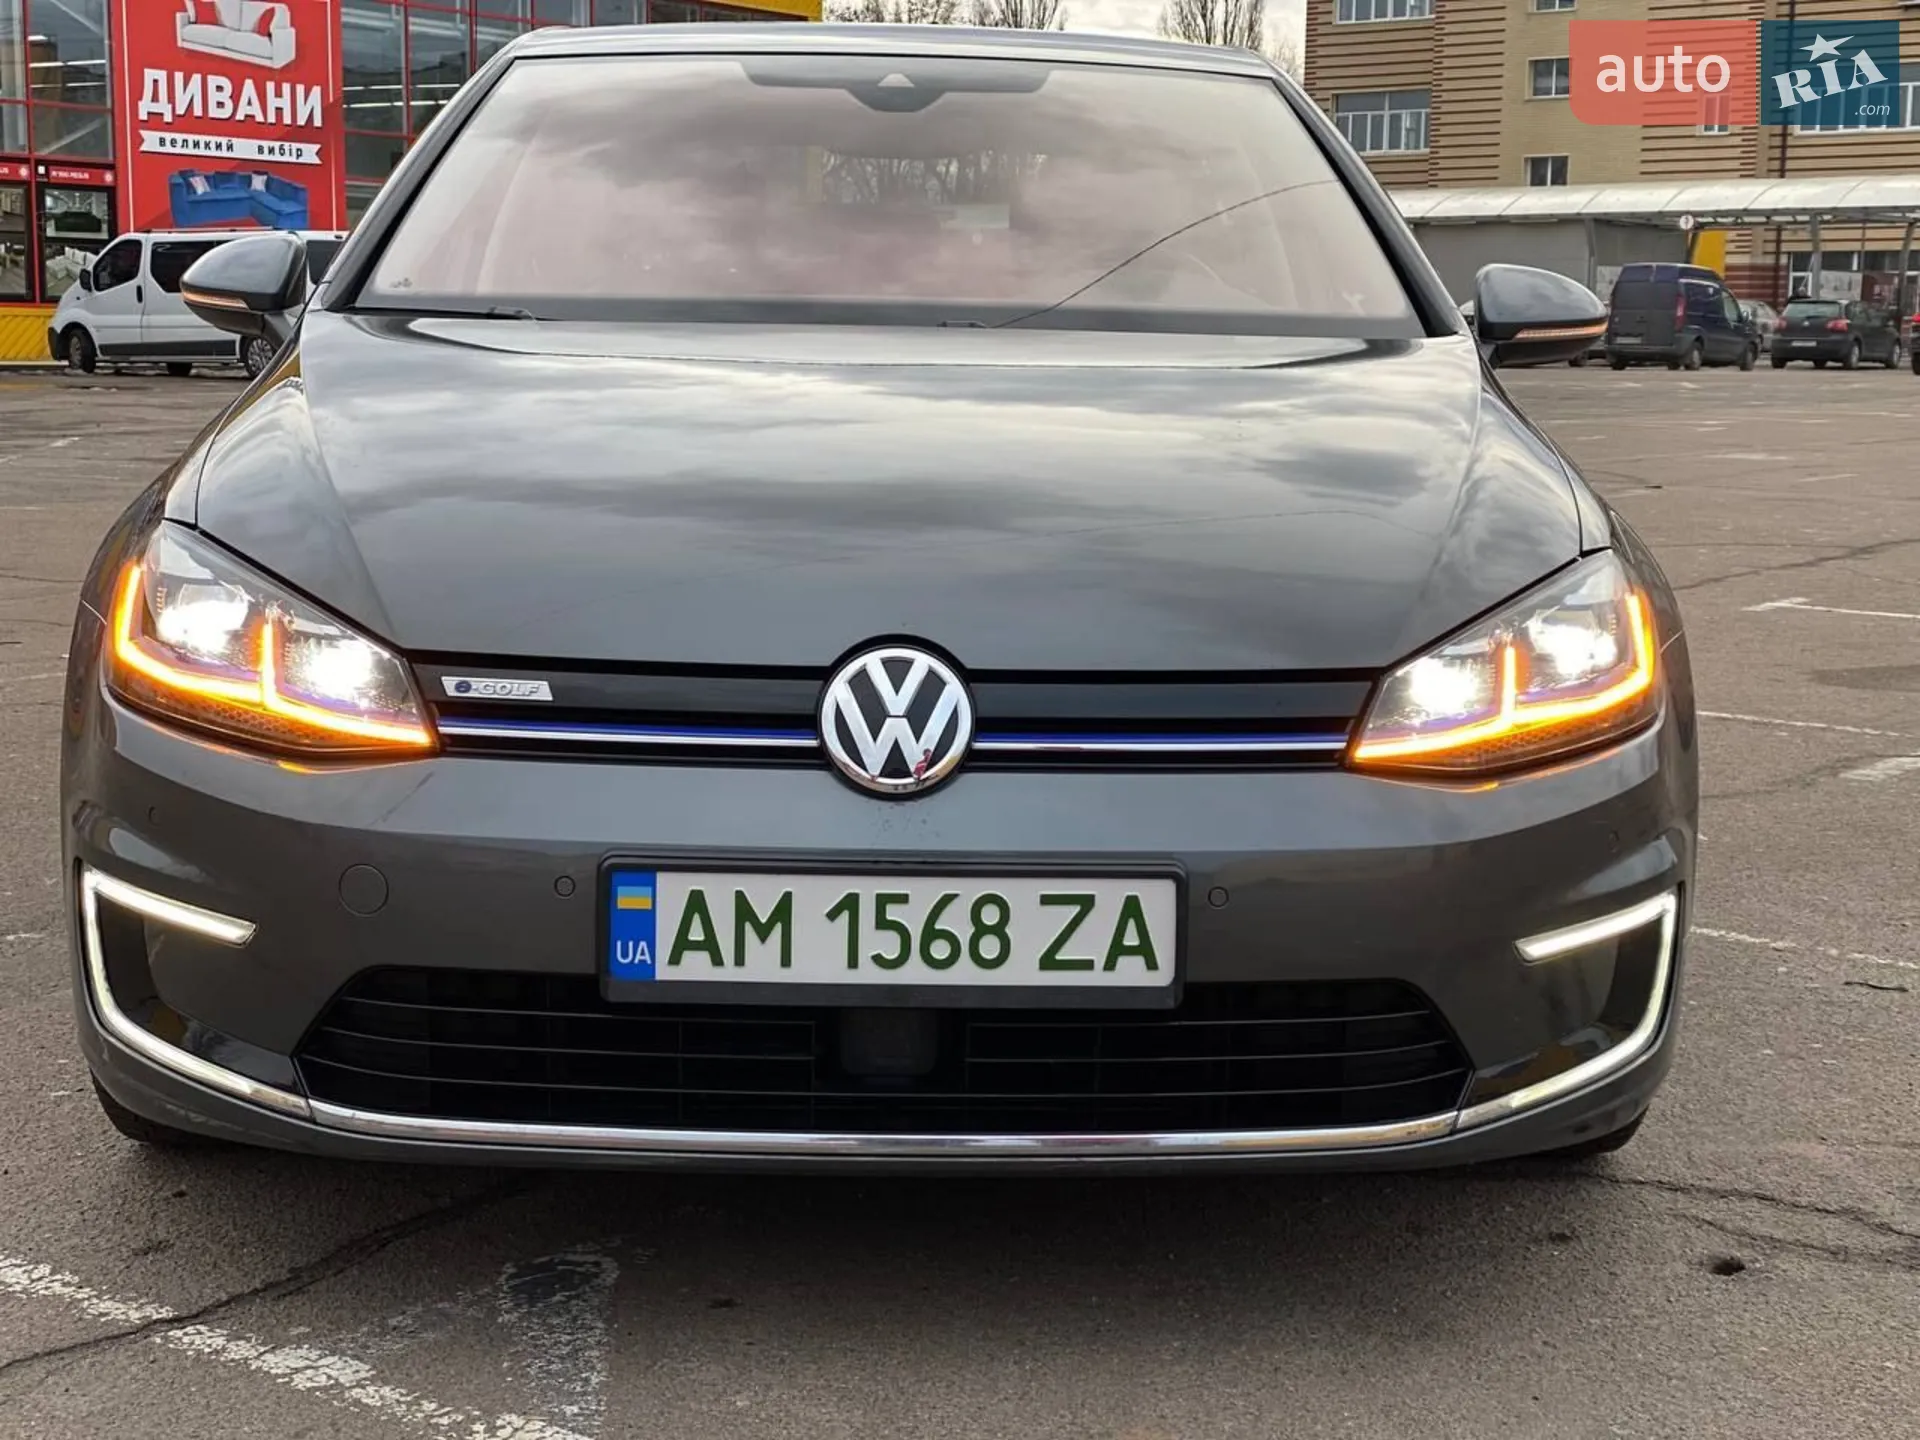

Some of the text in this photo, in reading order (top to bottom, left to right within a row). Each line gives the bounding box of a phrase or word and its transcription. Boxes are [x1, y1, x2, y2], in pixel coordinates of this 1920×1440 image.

[138, 68, 323, 128] ДИВАНИ
[158, 136, 304, 160] великий вибір
[667, 888, 1160, 972] AM 1568 ZA
[616, 940, 652, 965] UA
